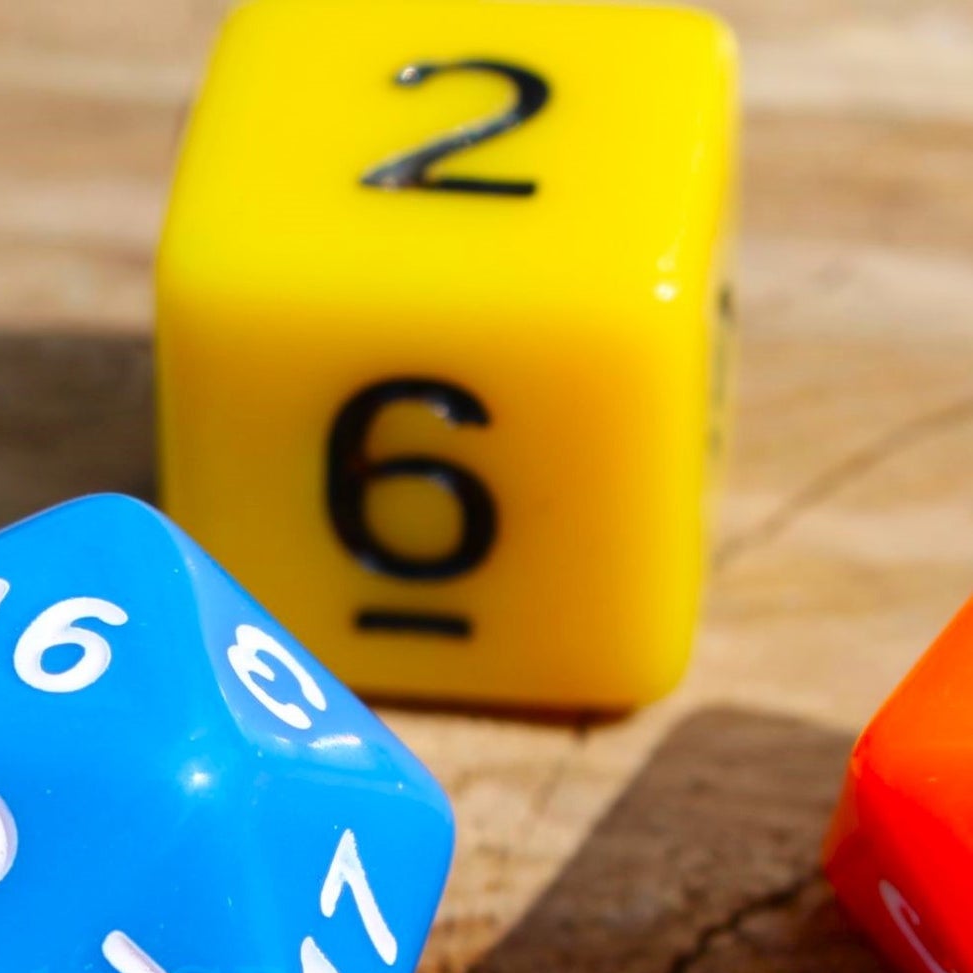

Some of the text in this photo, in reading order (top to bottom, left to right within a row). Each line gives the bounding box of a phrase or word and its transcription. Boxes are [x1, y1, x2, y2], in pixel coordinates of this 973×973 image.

[358, 57, 551, 198] 2
[323, 374, 500, 583] 6
[227, 624, 327, 729] 3
